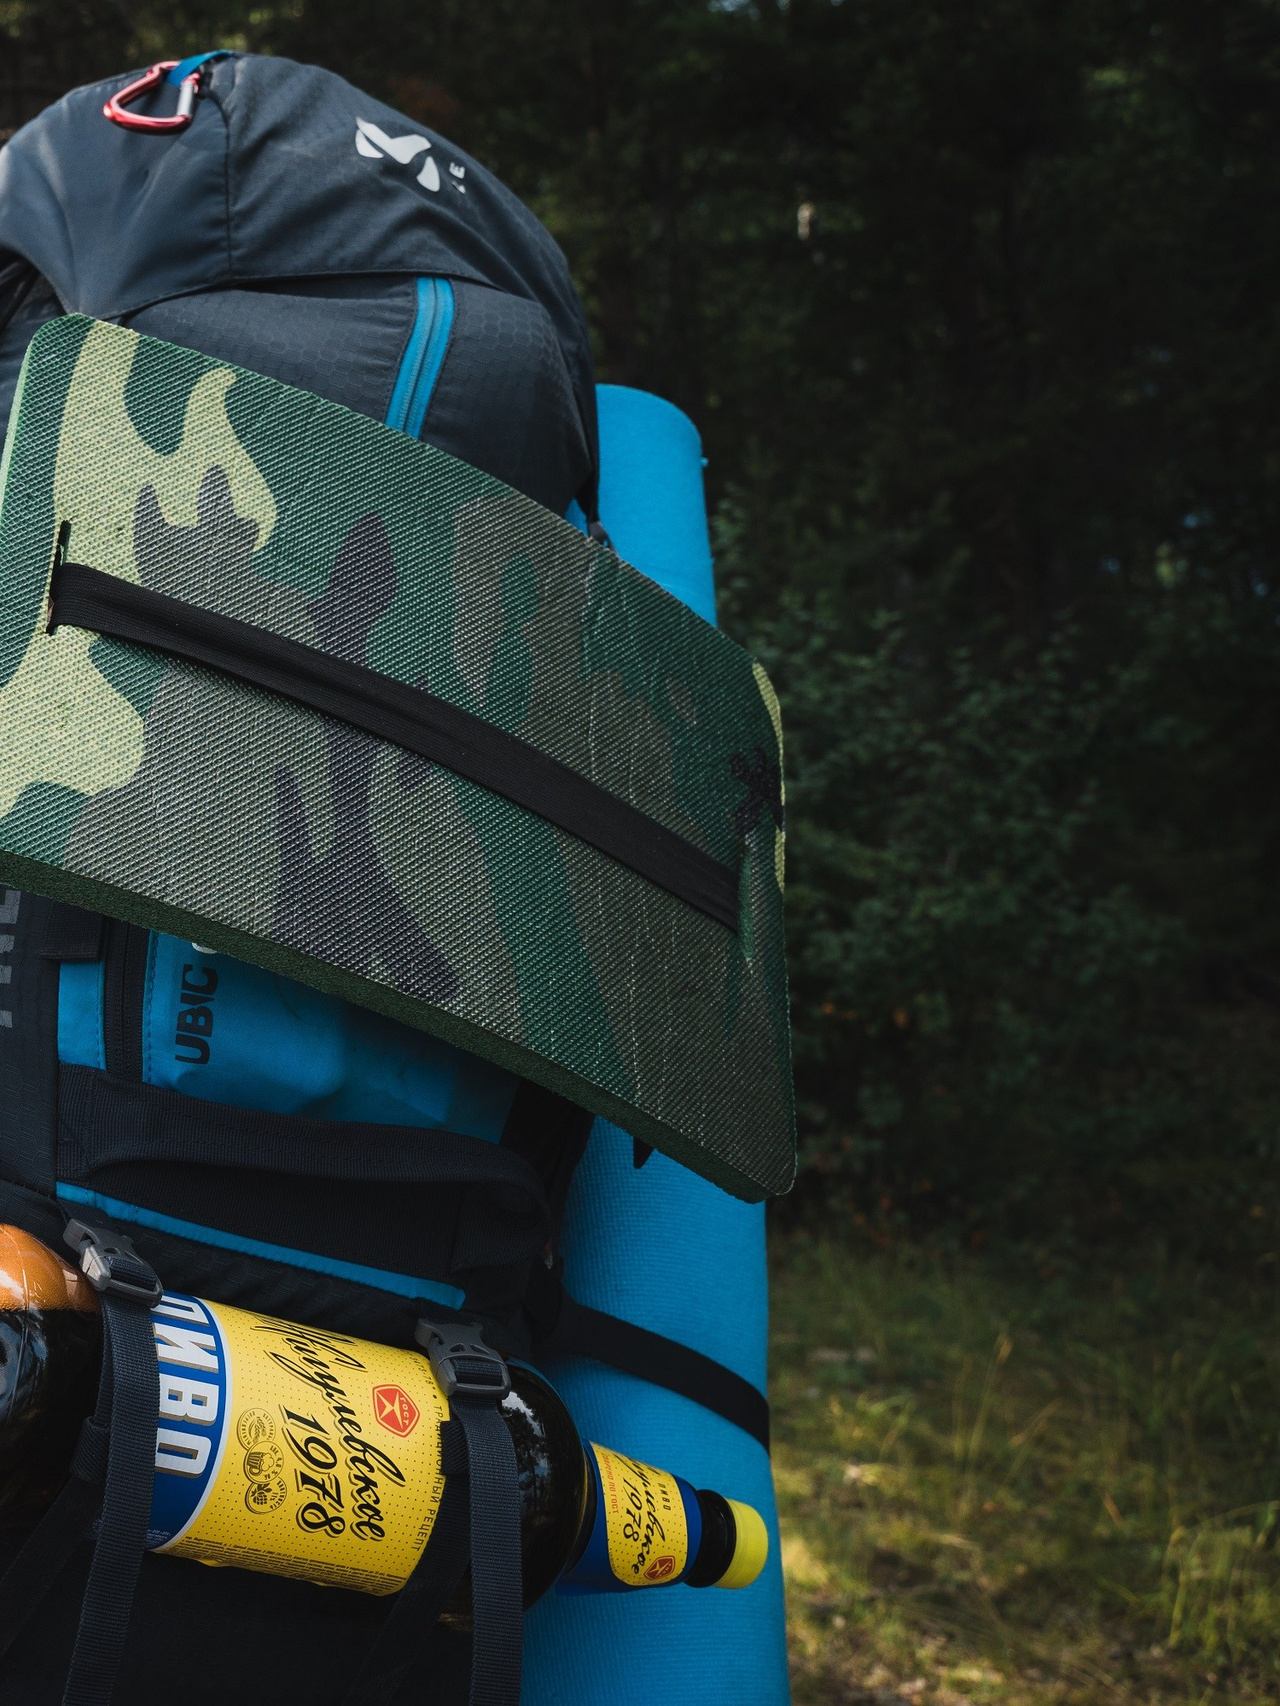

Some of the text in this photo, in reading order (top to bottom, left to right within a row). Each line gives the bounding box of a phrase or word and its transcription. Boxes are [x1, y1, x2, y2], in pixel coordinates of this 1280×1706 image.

[399, 1396, 410, 1426] ГОСТ
[279, 1403, 346, 1538] 1978
[411, 1508, 437, 1552] РЕЦЕПТ
[623, 1477, 643, 1542] 1978
